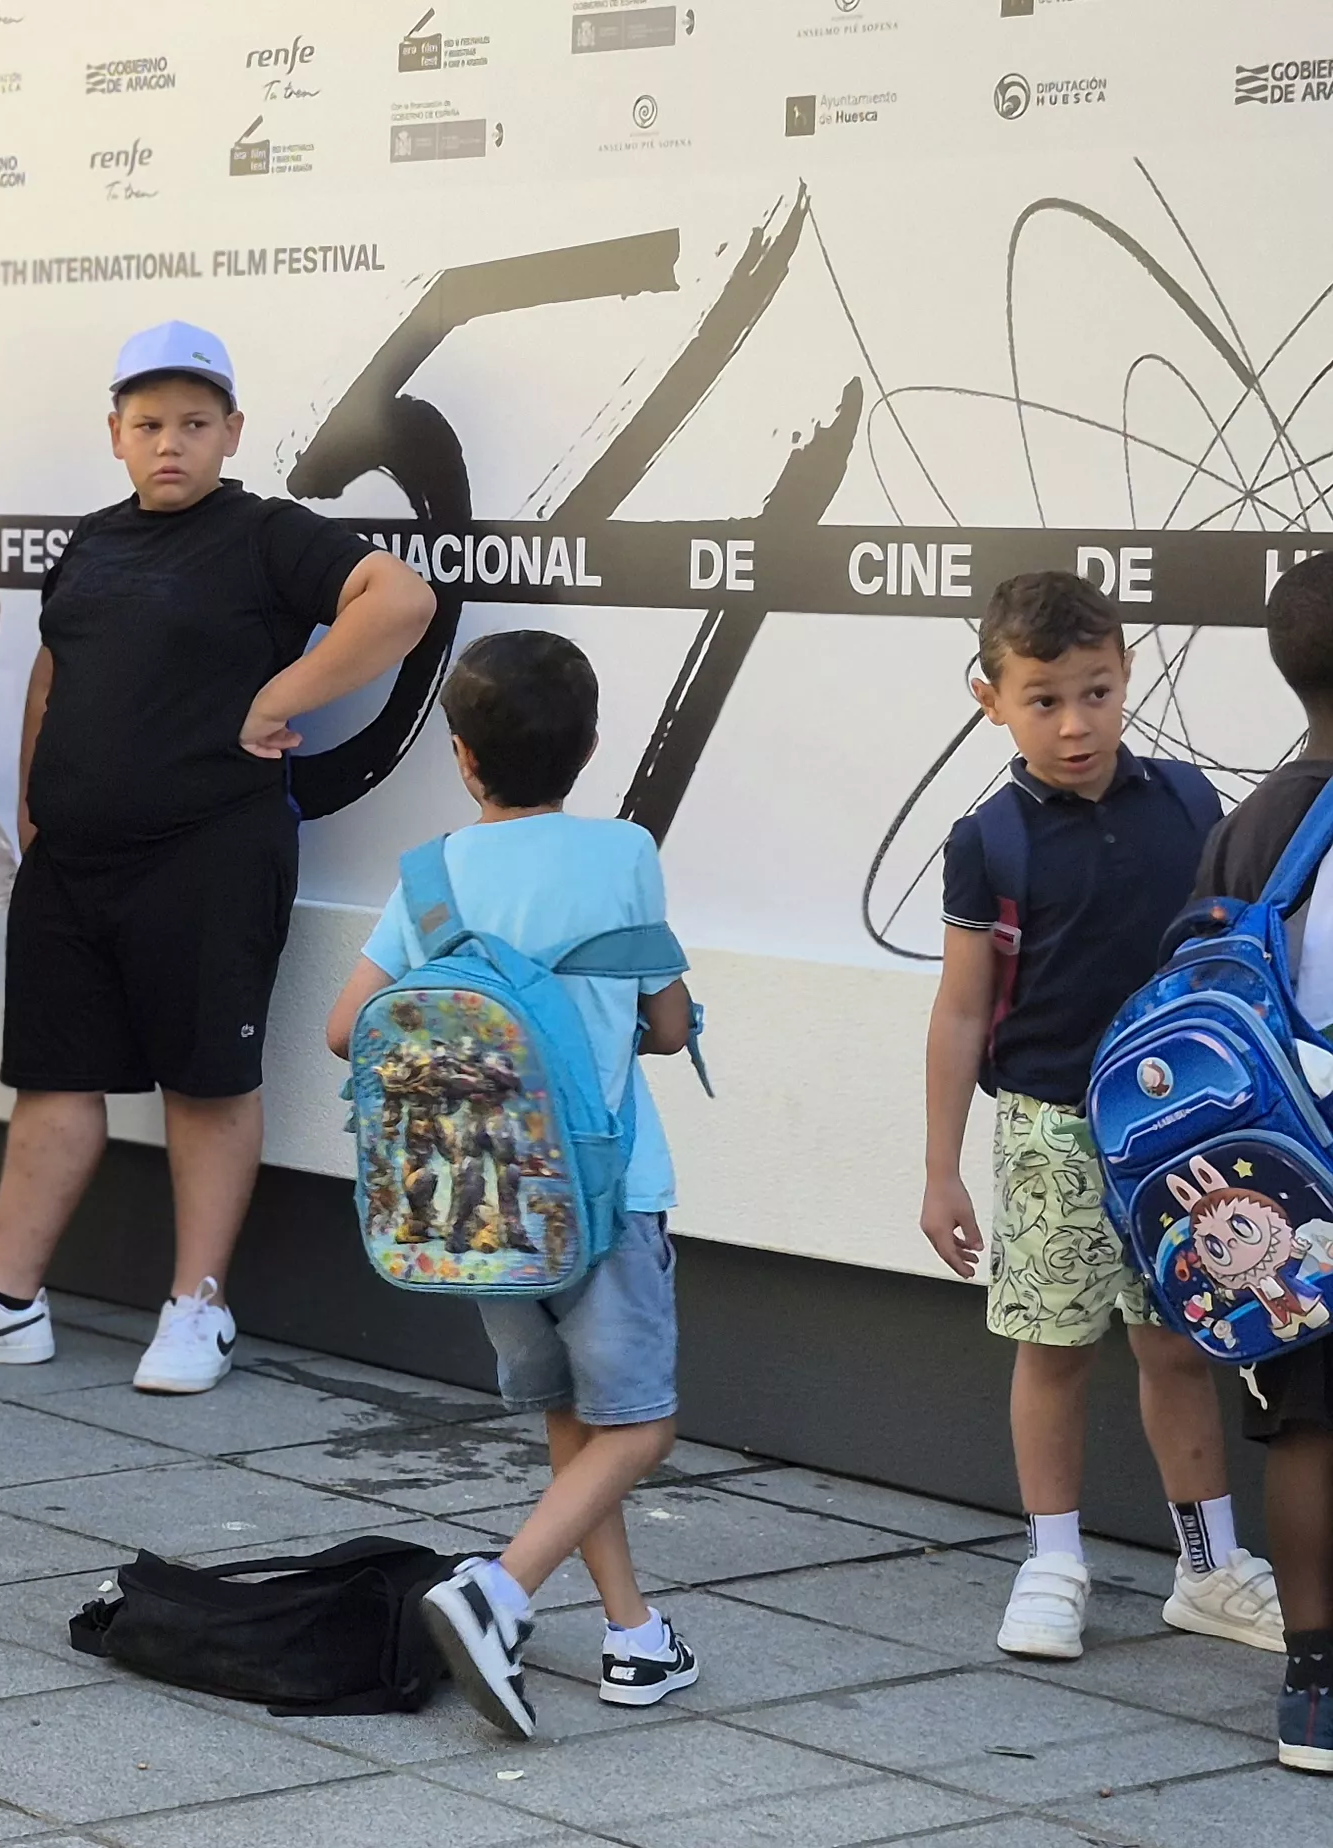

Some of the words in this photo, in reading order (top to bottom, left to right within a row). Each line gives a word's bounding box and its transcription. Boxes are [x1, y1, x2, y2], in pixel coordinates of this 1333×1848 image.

[246, 35, 314, 75] renfe
[107, 57, 168, 77] GOBIERNO
[107, 77, 122, 93] DE
[1036, 76, 1107, 94] DIPUTACIÓN
[1270, 84, 1295, 104] DE
[820, 91, 898, 109] Ayuntamiento
[1036, 91, 1106, 107] HUESCA
[835, 108, 878, 124] Huesca
[90, 137, 153, 176] renfe
[32, 250, 203, 285] INTERNATIONAL
[212, 248, 268, 277] FILM
[273, 243, 386, 275] FESTIVAL
[689, 539, 755, 592] DE
[848, 542, 973, 598] CINE
[1077, 546, 1153, 603] DE
